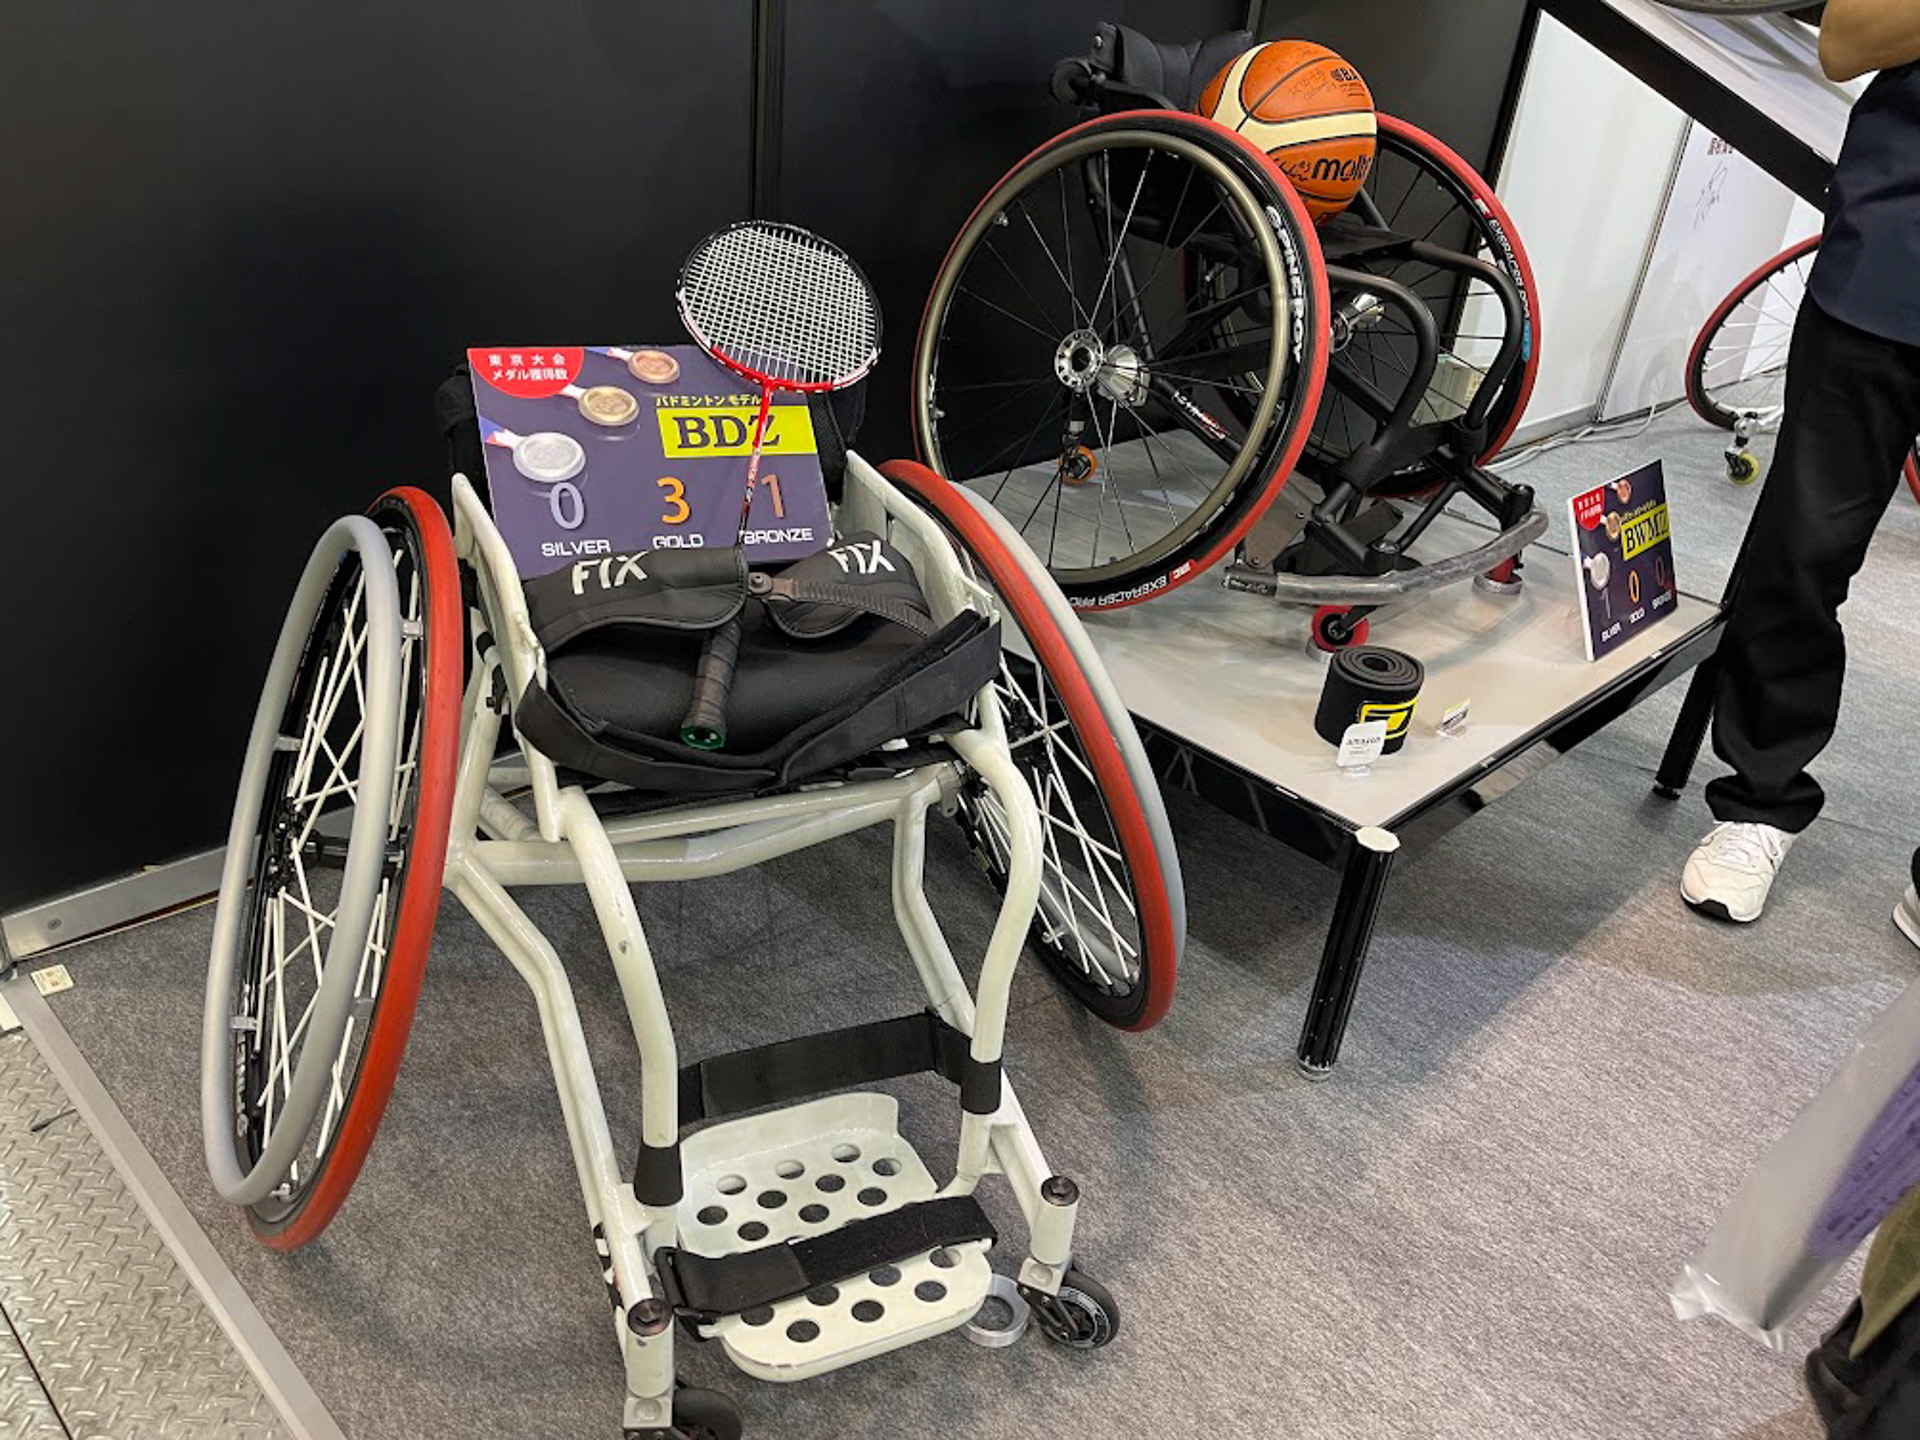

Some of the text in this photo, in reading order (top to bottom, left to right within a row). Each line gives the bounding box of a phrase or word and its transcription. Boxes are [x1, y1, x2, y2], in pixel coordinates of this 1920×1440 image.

[489, 354, 566, 367] 東京大会
[493, 368, 569, 381] メダル獲得数
[673, 414, 780, 449] BDZ
[550, 482, 585, 530] 0
[656, 476, 690, 525] 3
[762, 474, 784, 518] 1
[541, 528, 813, 556] SILVER GOLD BRONZE
[828, 540, 896, 574] FIX
[573, 550, 648, 595] FIX
